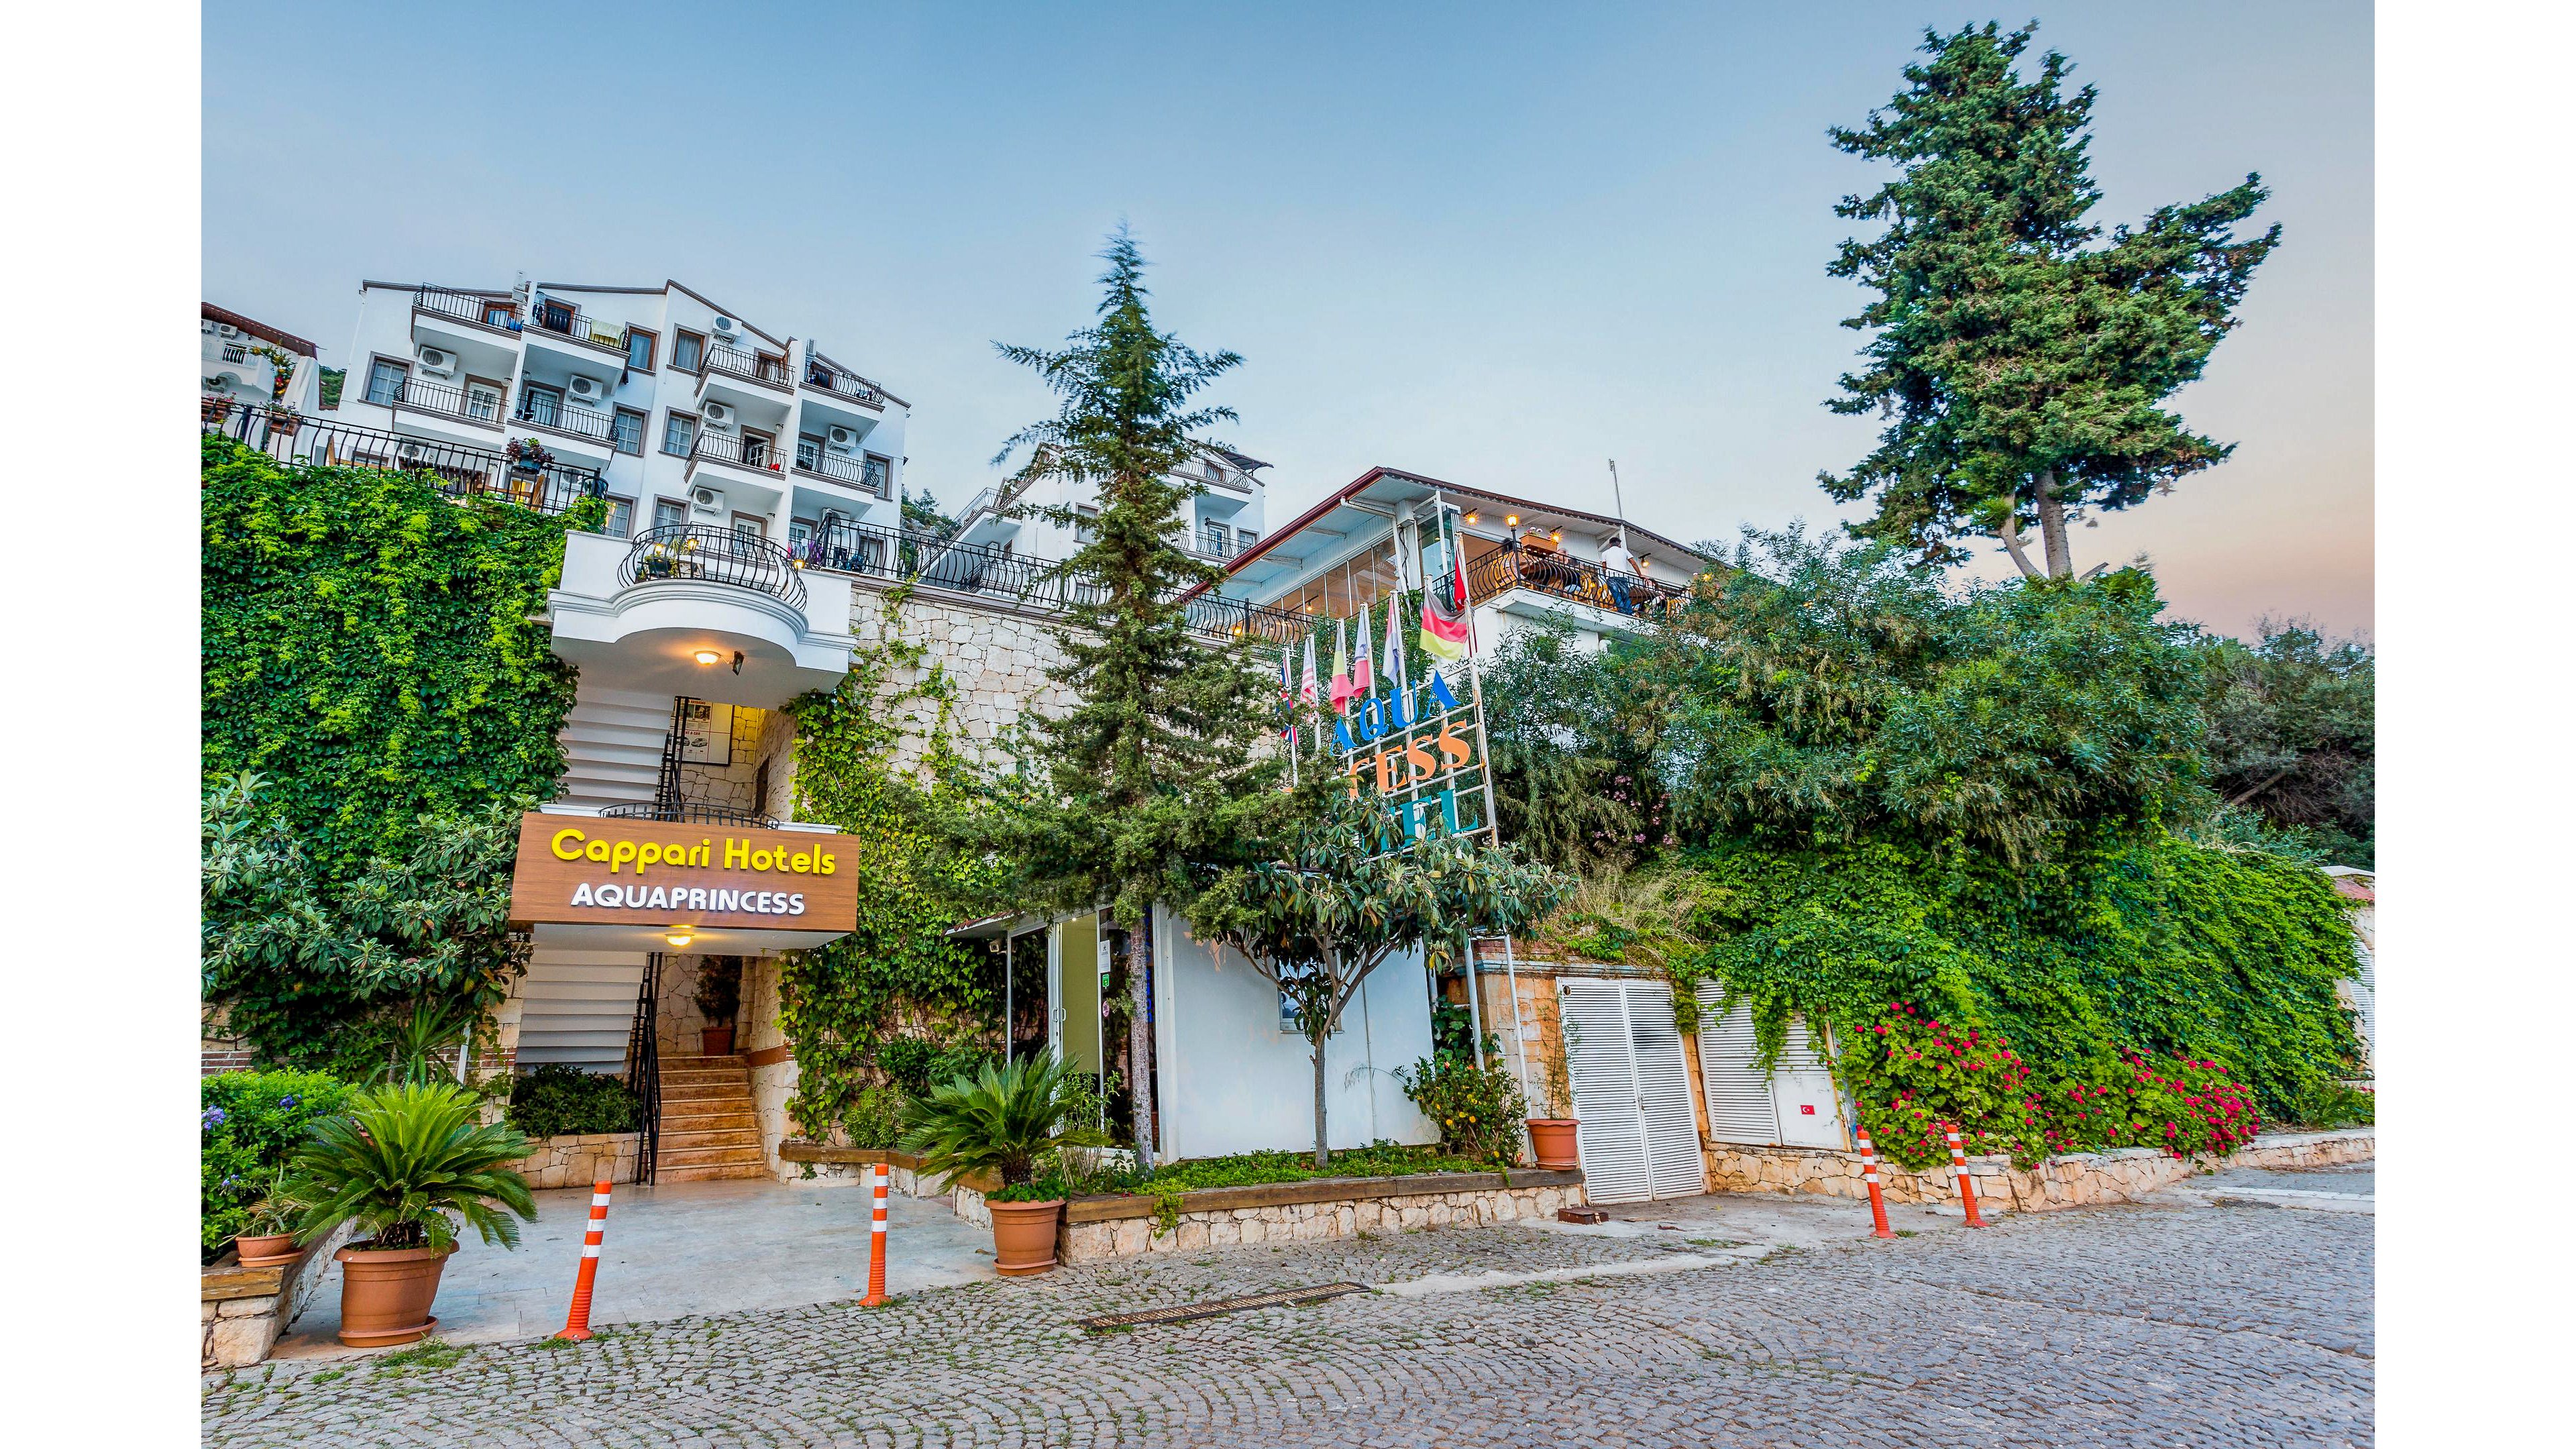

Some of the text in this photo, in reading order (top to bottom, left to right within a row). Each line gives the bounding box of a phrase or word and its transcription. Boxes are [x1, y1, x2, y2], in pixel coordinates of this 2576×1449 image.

[1330, 670, 1461, 756] AQUA
[551, 828, 837, 875] Cappari Hotels
[570, 882, 806, 915] AQUAPRINCESS
